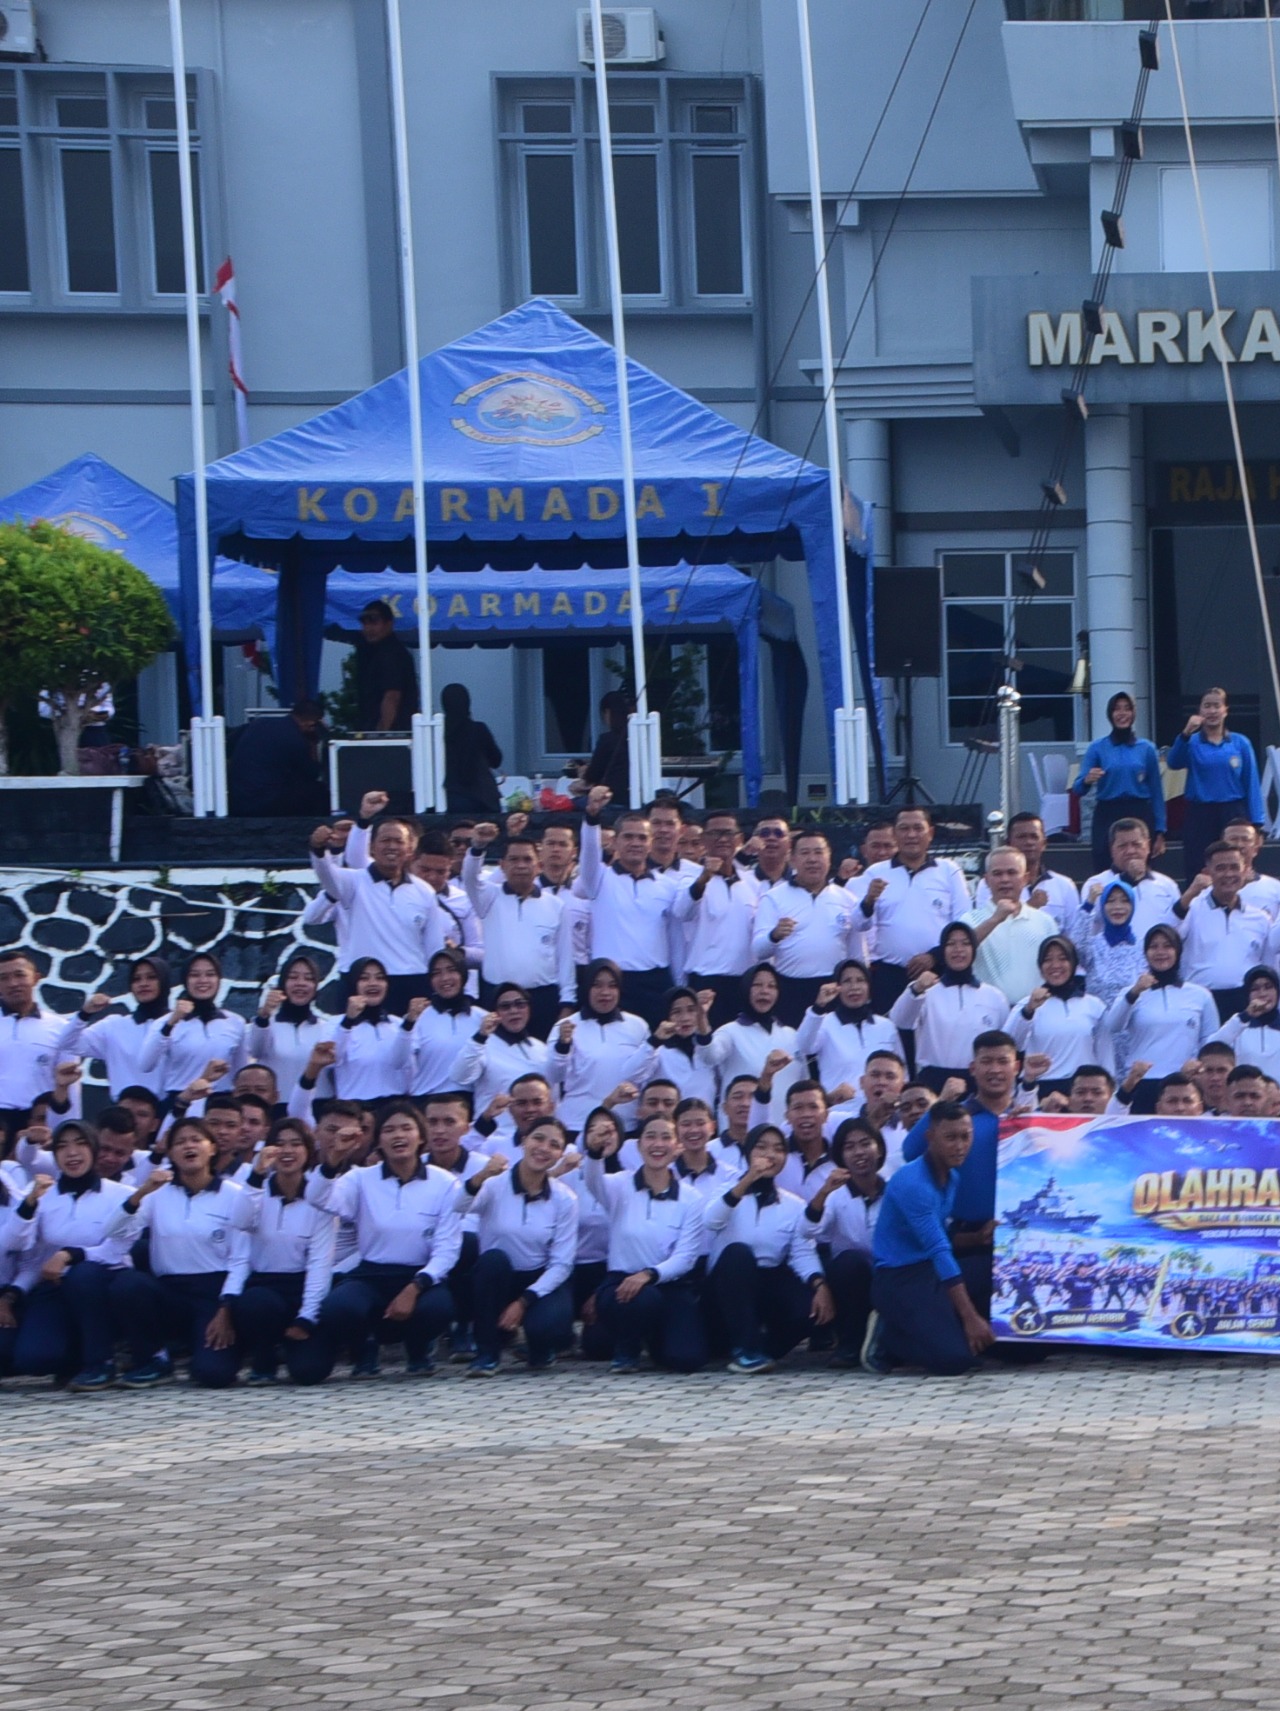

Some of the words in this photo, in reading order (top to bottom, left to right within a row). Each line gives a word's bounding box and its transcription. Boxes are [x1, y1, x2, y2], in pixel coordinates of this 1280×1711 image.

[297, 485, 666, 522] KOARMADA
[702, 482, 725, 517] I
[1169, 464, 1258, 503] RAJA
[381, 590, 642, 618] KOARMADA
[665, 588, 683, 612] I
